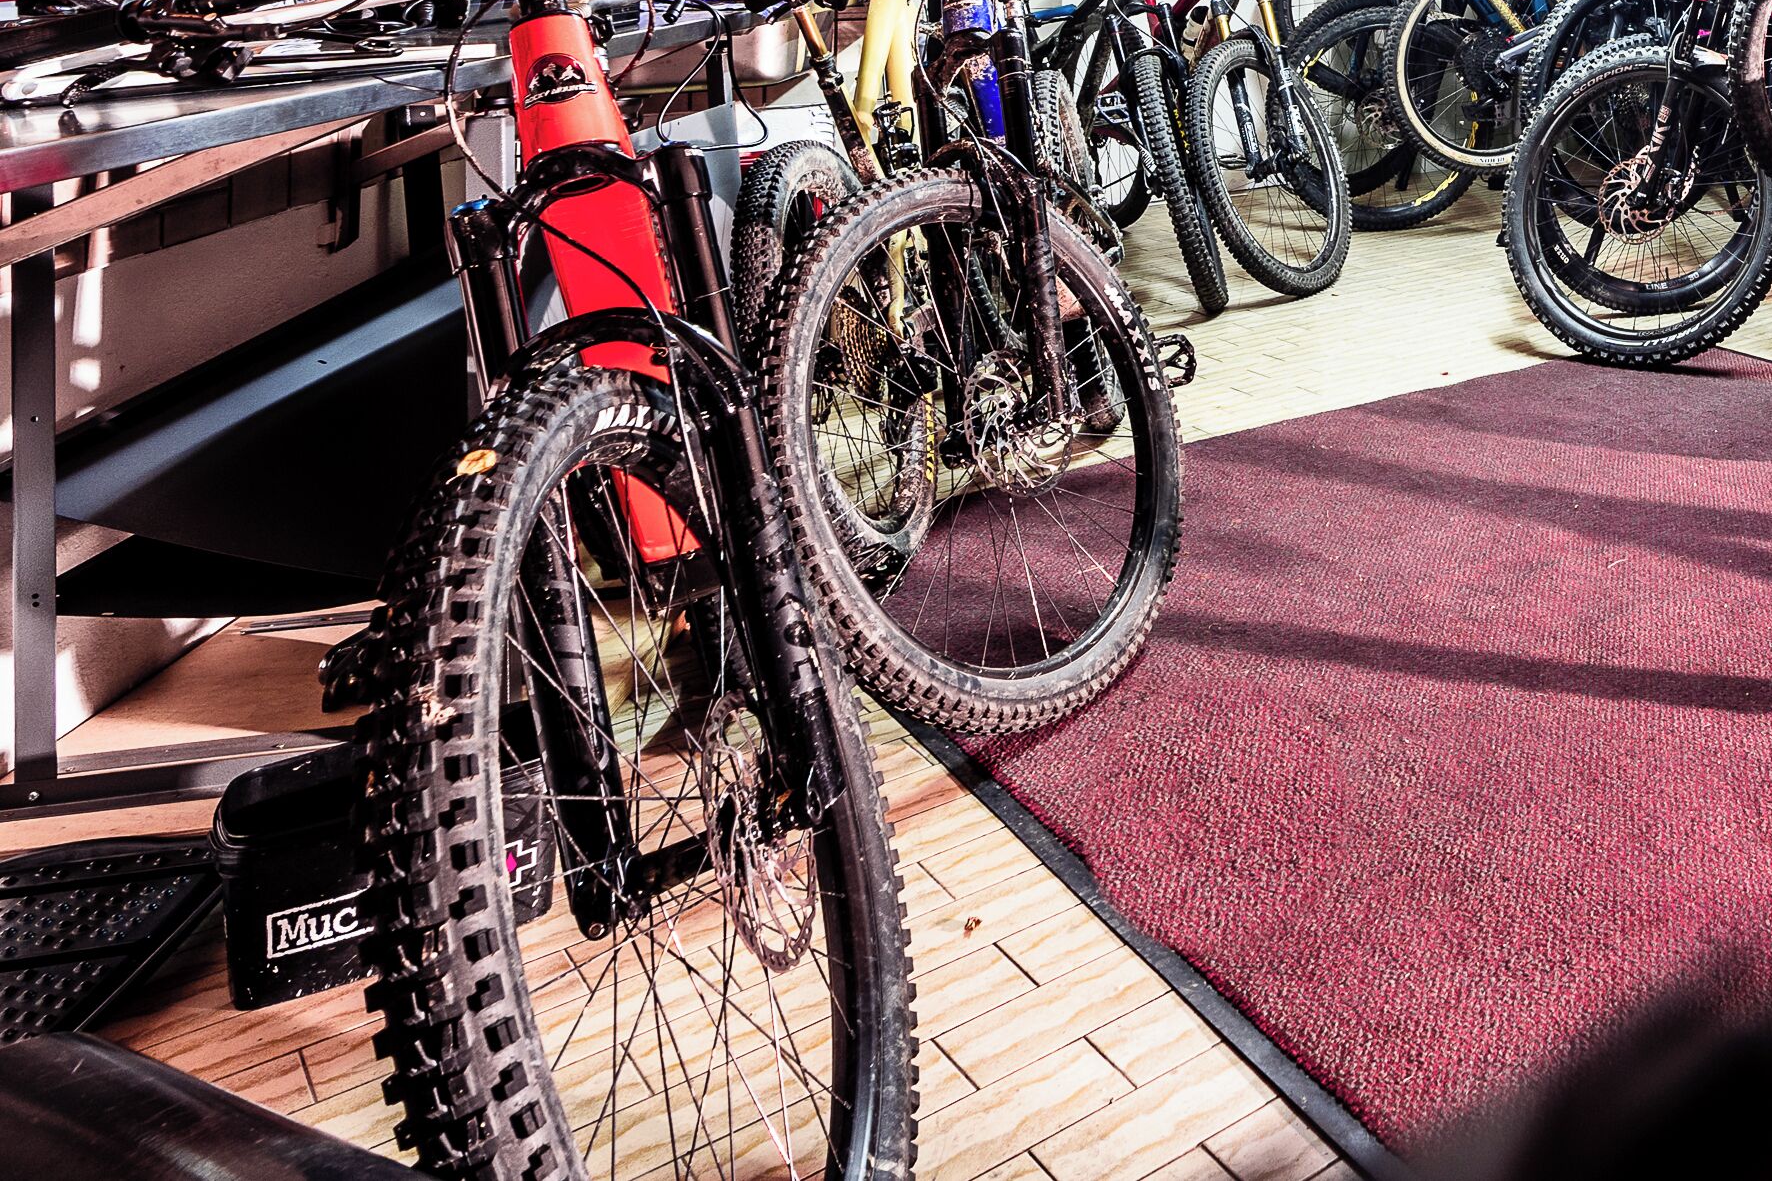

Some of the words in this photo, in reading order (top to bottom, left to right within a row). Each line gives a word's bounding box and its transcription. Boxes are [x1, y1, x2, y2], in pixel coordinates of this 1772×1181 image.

[1572, 64, 1634, 97] SCORPION
[1645, 281, 1669, 291] LINE
[1104, 282, 1161, 391] MAXXIS
[1643, 322, 1700, 347] PIRELLI
